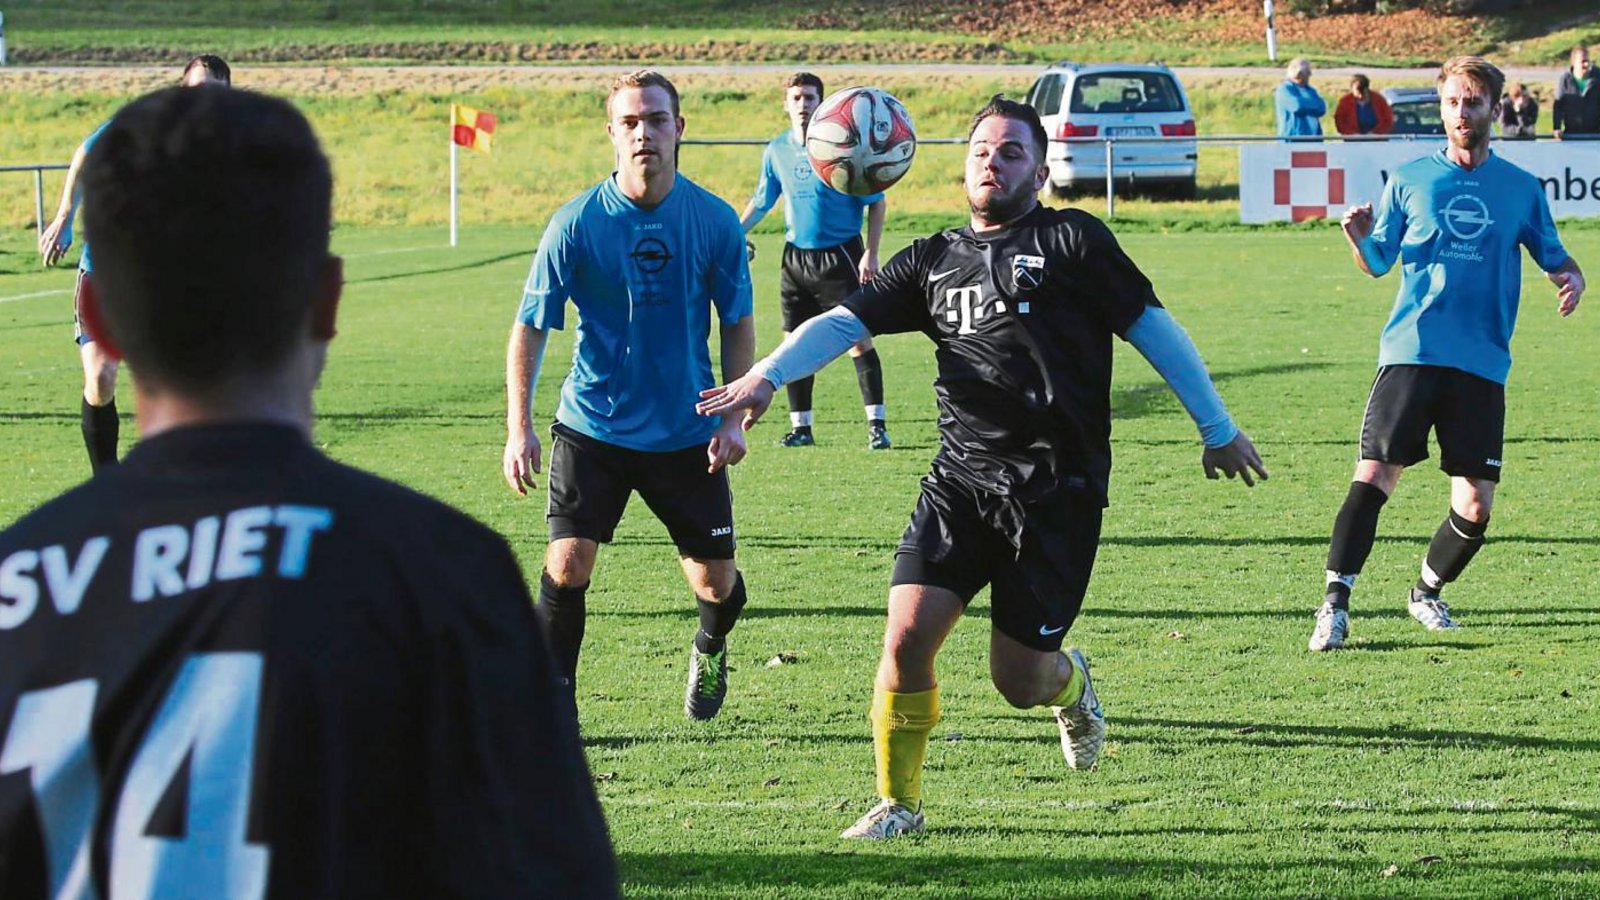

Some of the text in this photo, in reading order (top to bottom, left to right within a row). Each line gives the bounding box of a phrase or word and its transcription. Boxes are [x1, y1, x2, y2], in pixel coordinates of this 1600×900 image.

[1451, 241, 1477, 252] Weller
[711, 526, 731, 536] JAKO
[0, 506, 332, 629] SV RIET
[0, 651, 271, 900] 14
